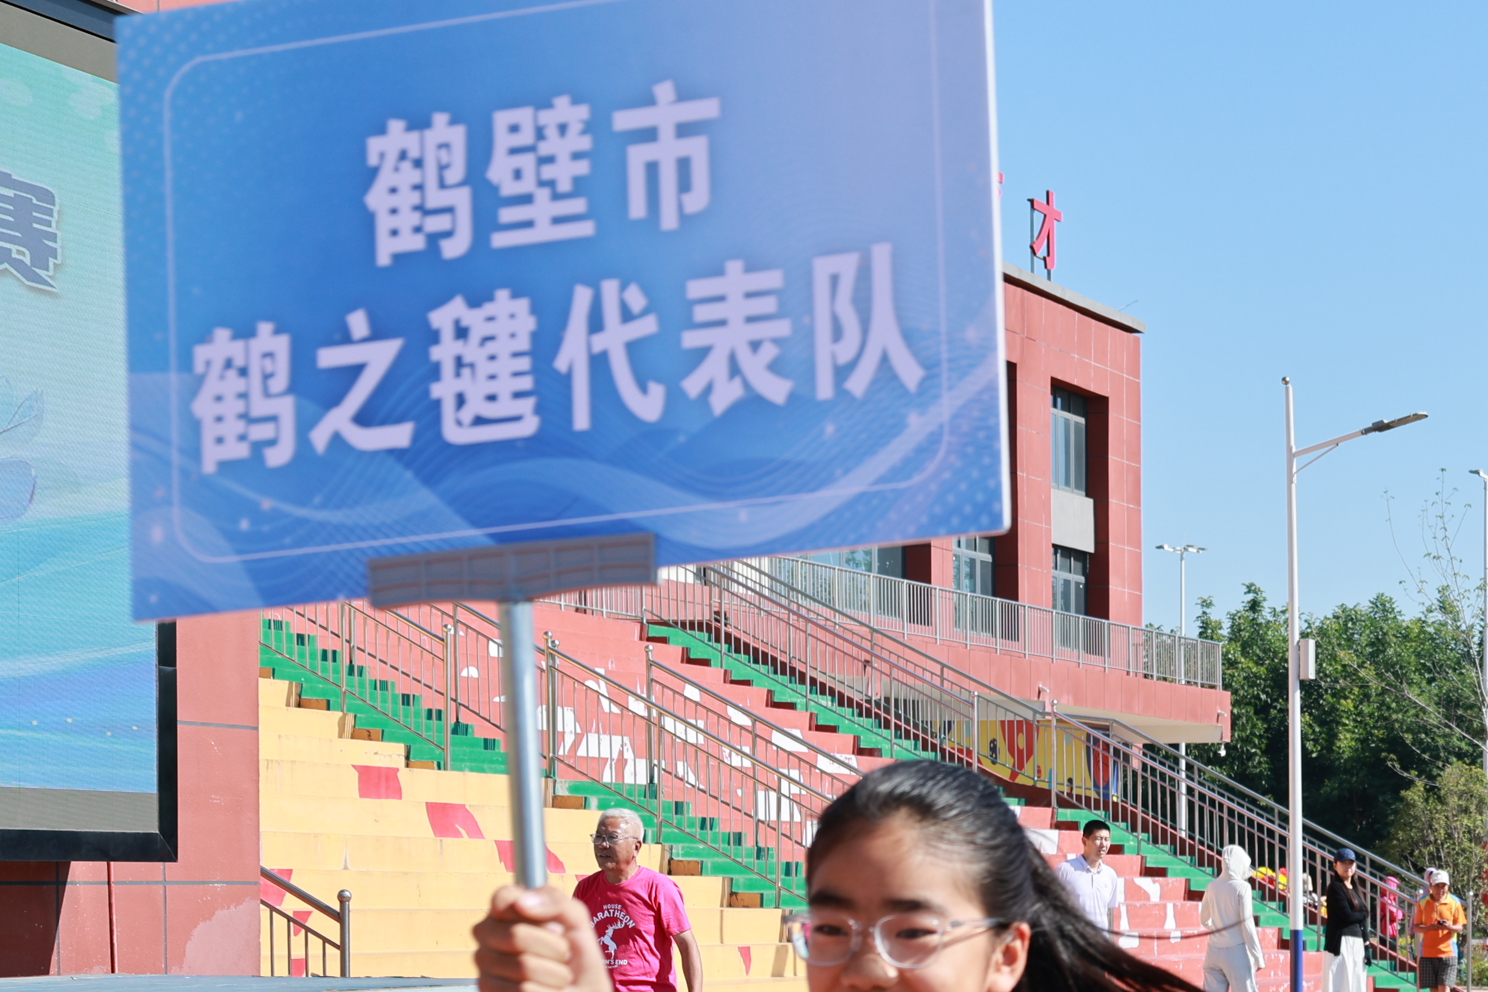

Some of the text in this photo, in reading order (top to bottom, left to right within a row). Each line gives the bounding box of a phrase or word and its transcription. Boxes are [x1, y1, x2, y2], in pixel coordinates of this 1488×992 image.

[364, 78, 722, 268] 鹤壁市
[190, 242, 927, 476] 鹤之毽代表队
